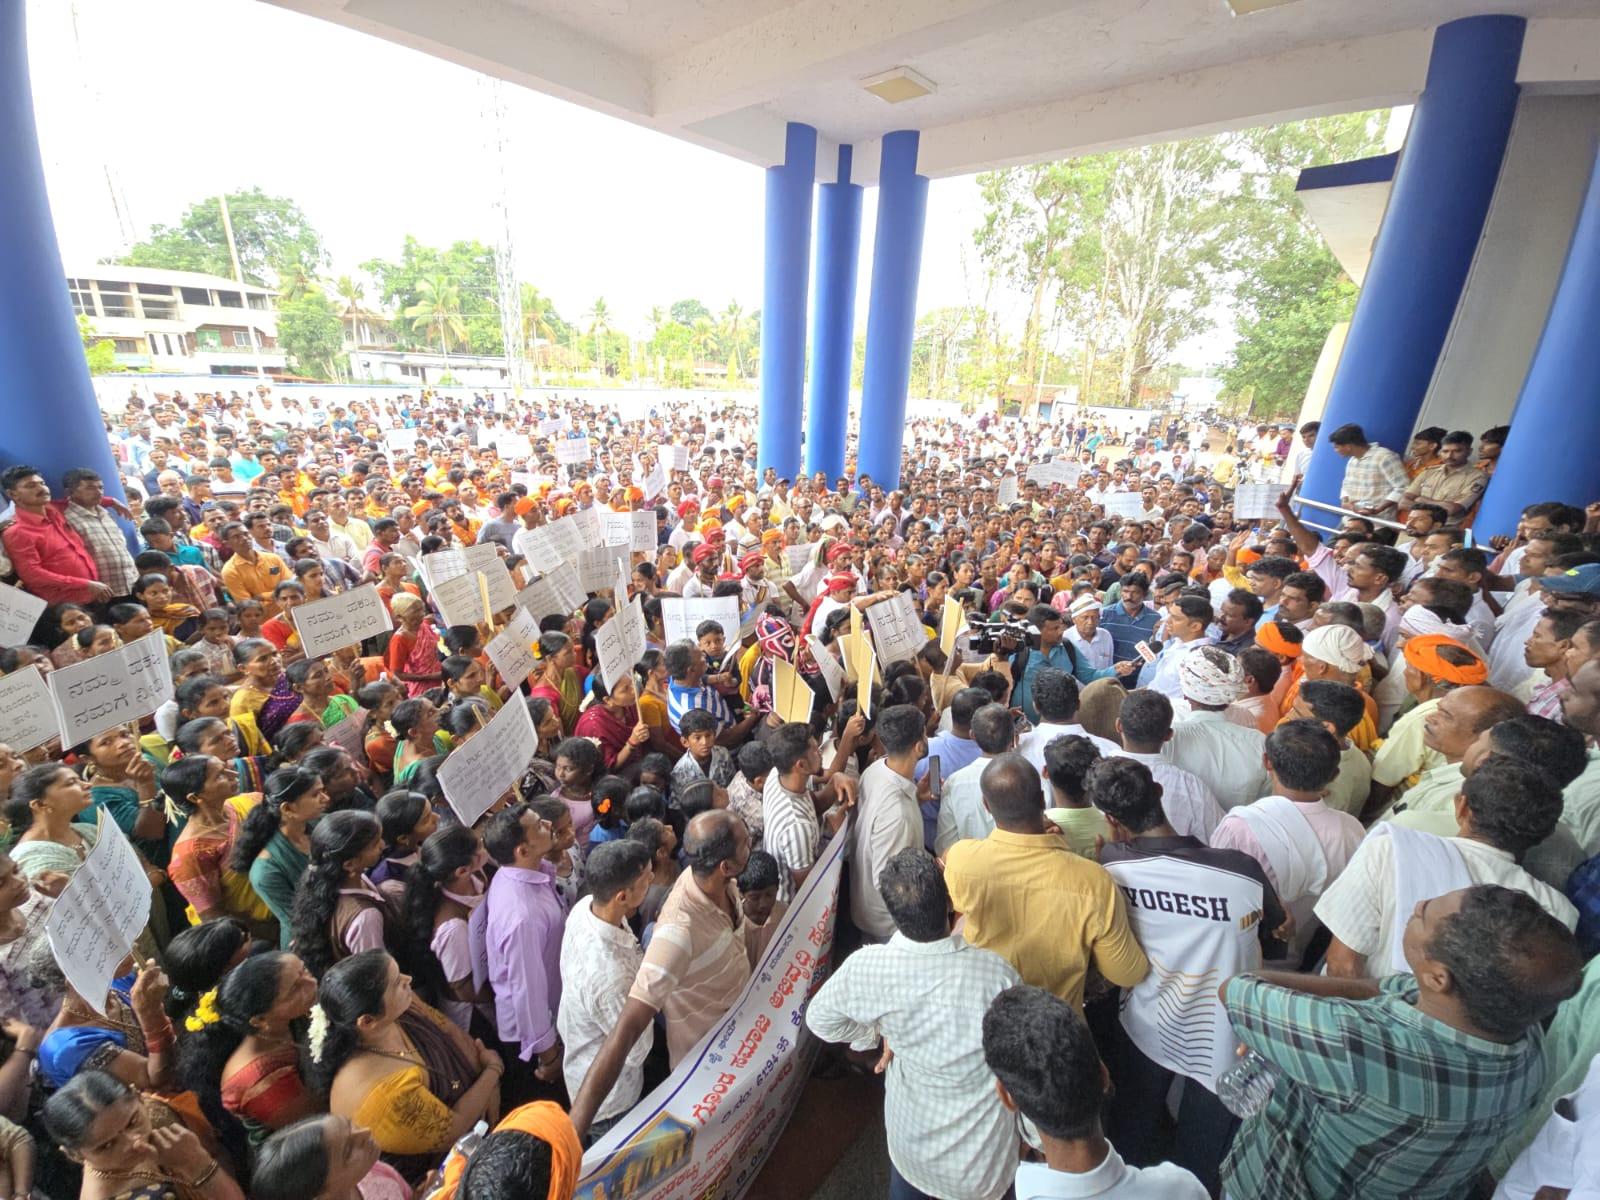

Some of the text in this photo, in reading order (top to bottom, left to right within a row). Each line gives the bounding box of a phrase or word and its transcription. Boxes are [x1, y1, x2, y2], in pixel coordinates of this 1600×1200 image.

[1122, 887, 1231, 922] YOGESH
[730, 1013, 772, 1069] ಸಮಾಜ
[769, 948, 817, 1009] ಅಭಿವೃದ್ಧಿ
